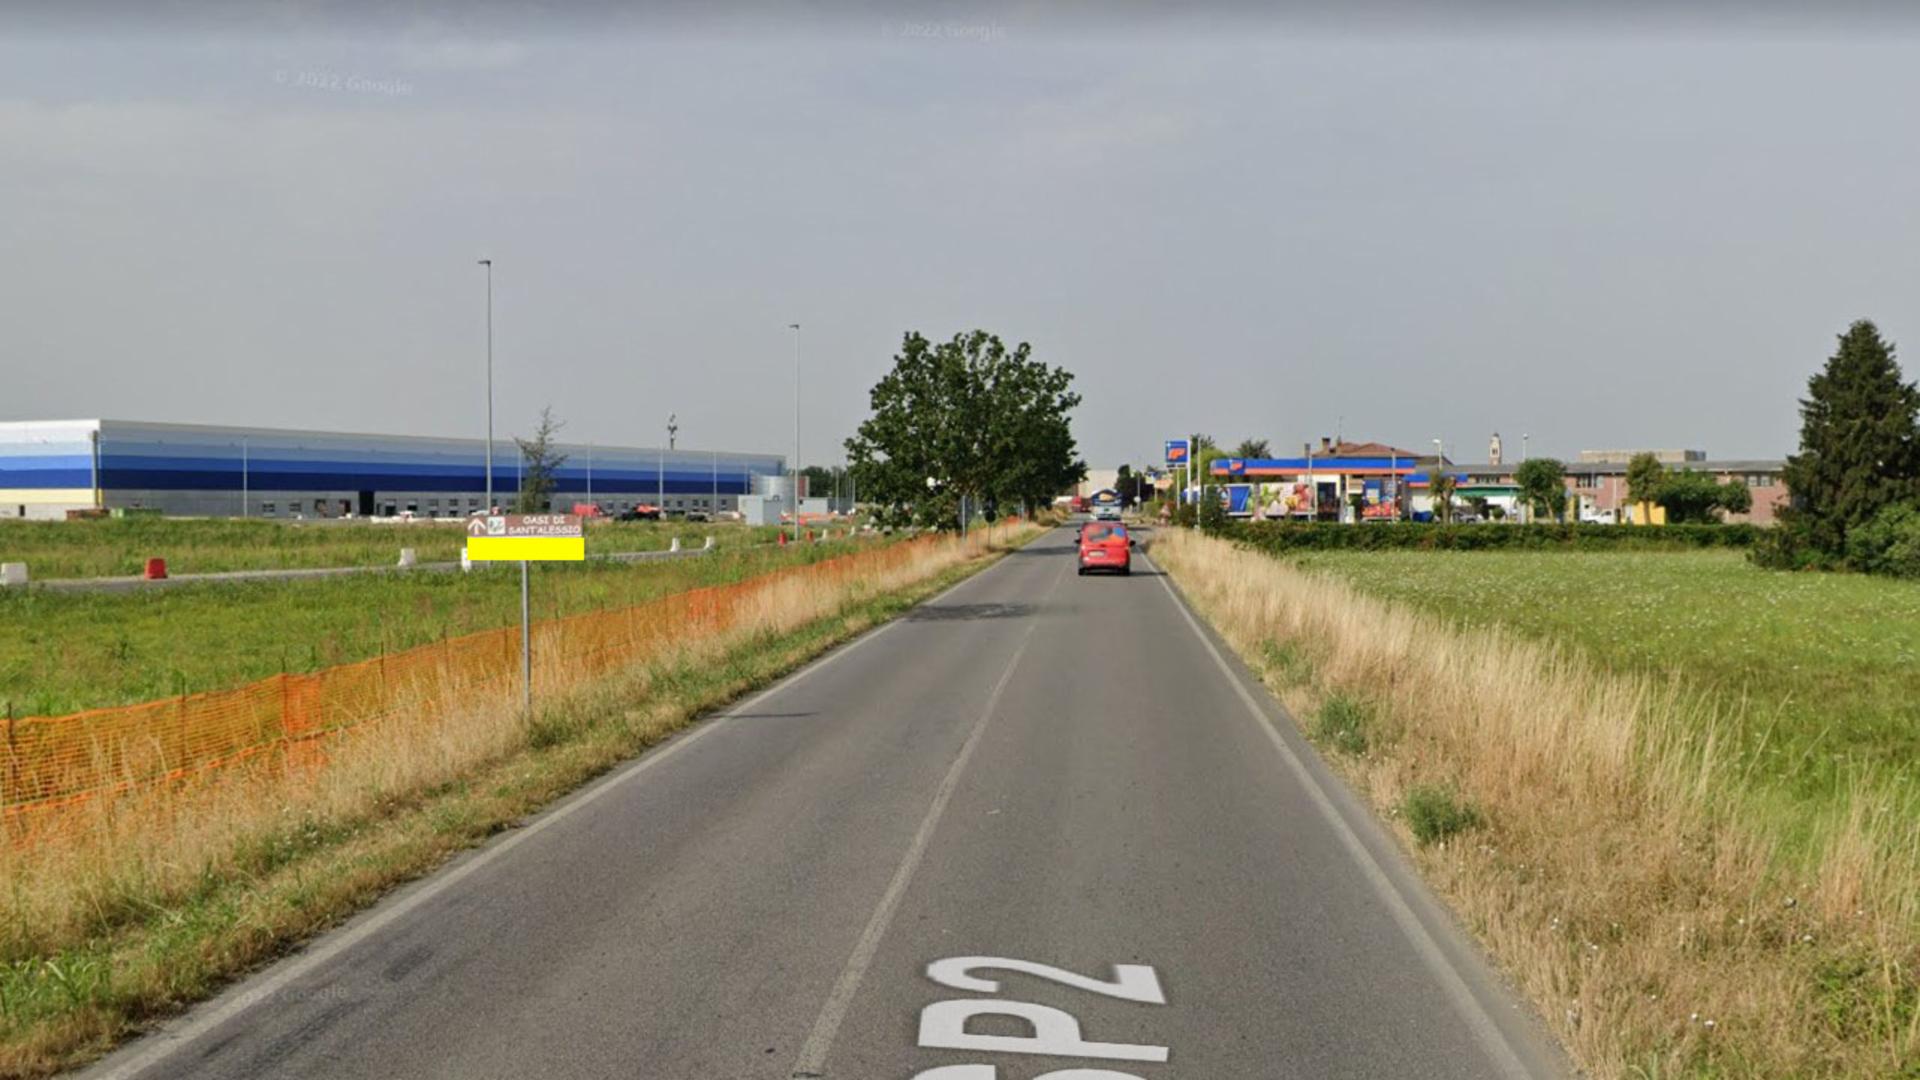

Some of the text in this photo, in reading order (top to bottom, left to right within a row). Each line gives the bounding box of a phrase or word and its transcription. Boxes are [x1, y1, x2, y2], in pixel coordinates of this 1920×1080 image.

[523, 515, 566, 525] OASI DI
[909, 956, 1170, 1080] P2
